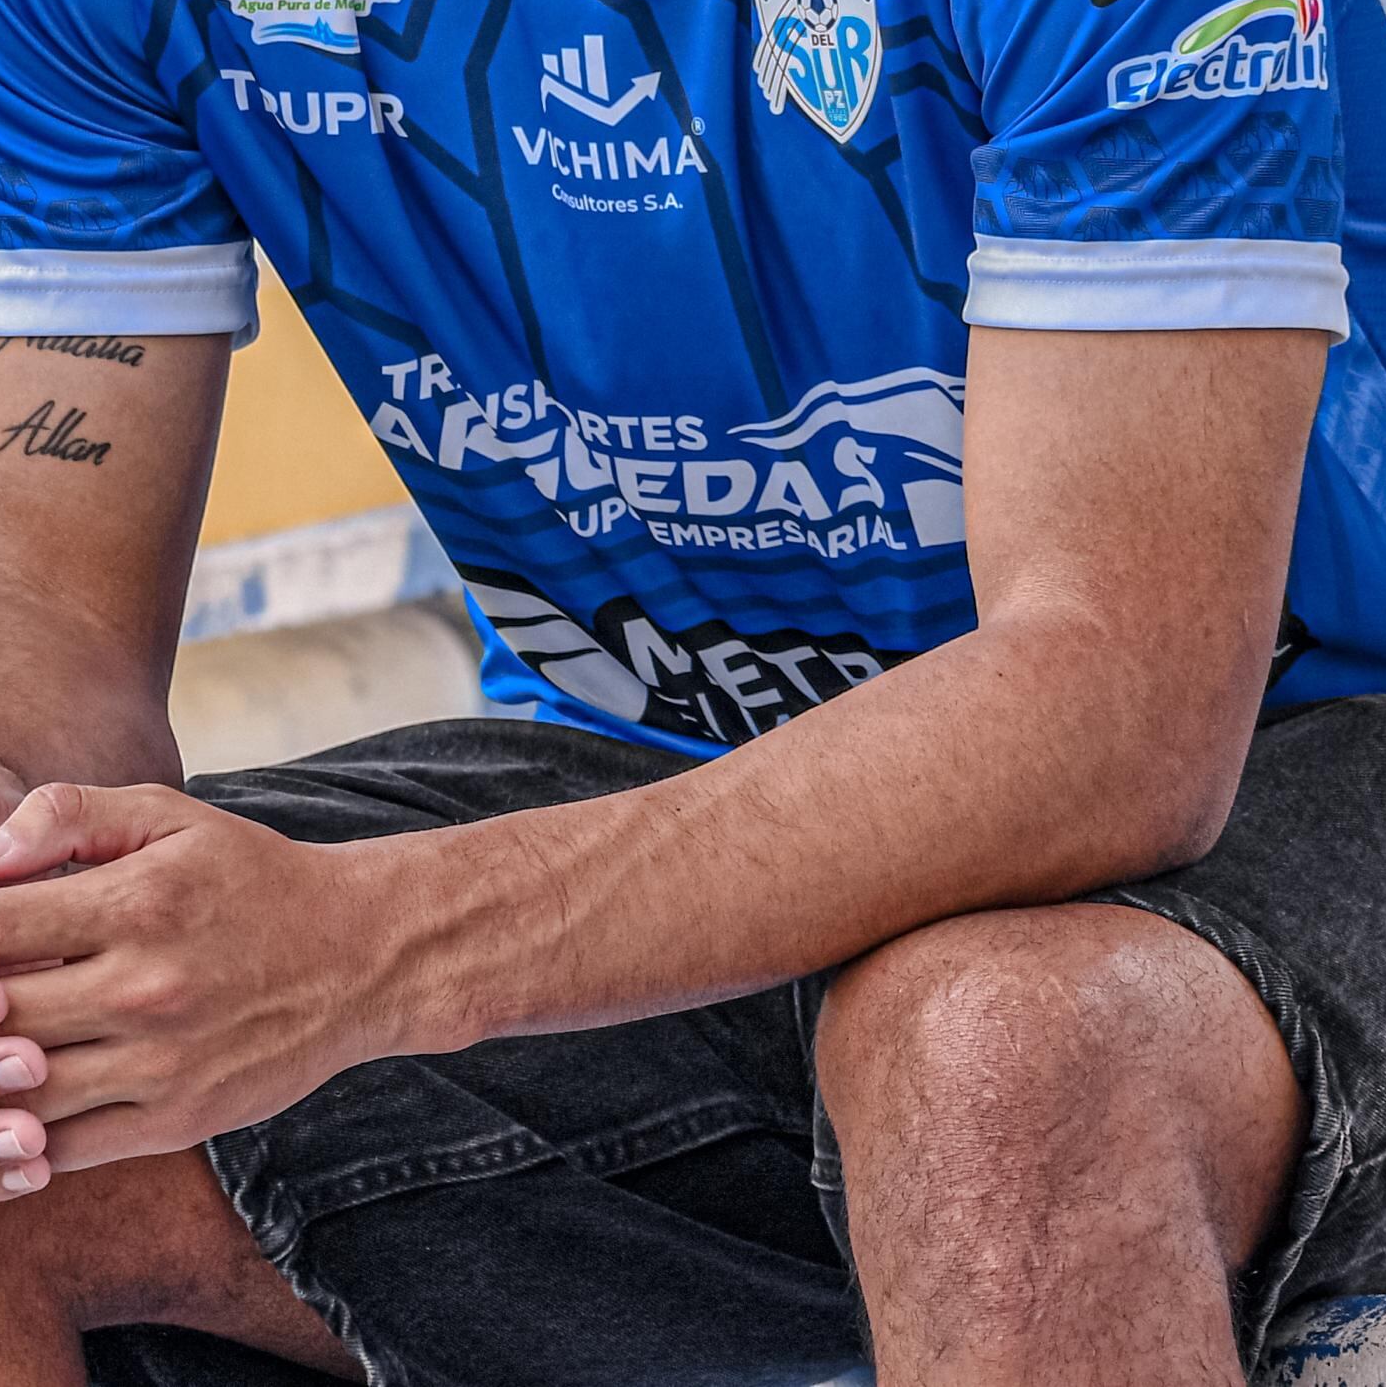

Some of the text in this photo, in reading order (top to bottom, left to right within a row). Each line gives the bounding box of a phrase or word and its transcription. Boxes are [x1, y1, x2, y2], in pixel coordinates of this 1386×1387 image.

[238, 0, 274, 13] Agua
[277, 0, 310, 11] Pura
[812, 34, 835, 46] DEL
[773, 16, 871, 126] SUR
[824, 90, 846, 108] PZ
[643, 192, 684, 211] S.A.
[646, 514, 908, 559] EMPRESARIAL
